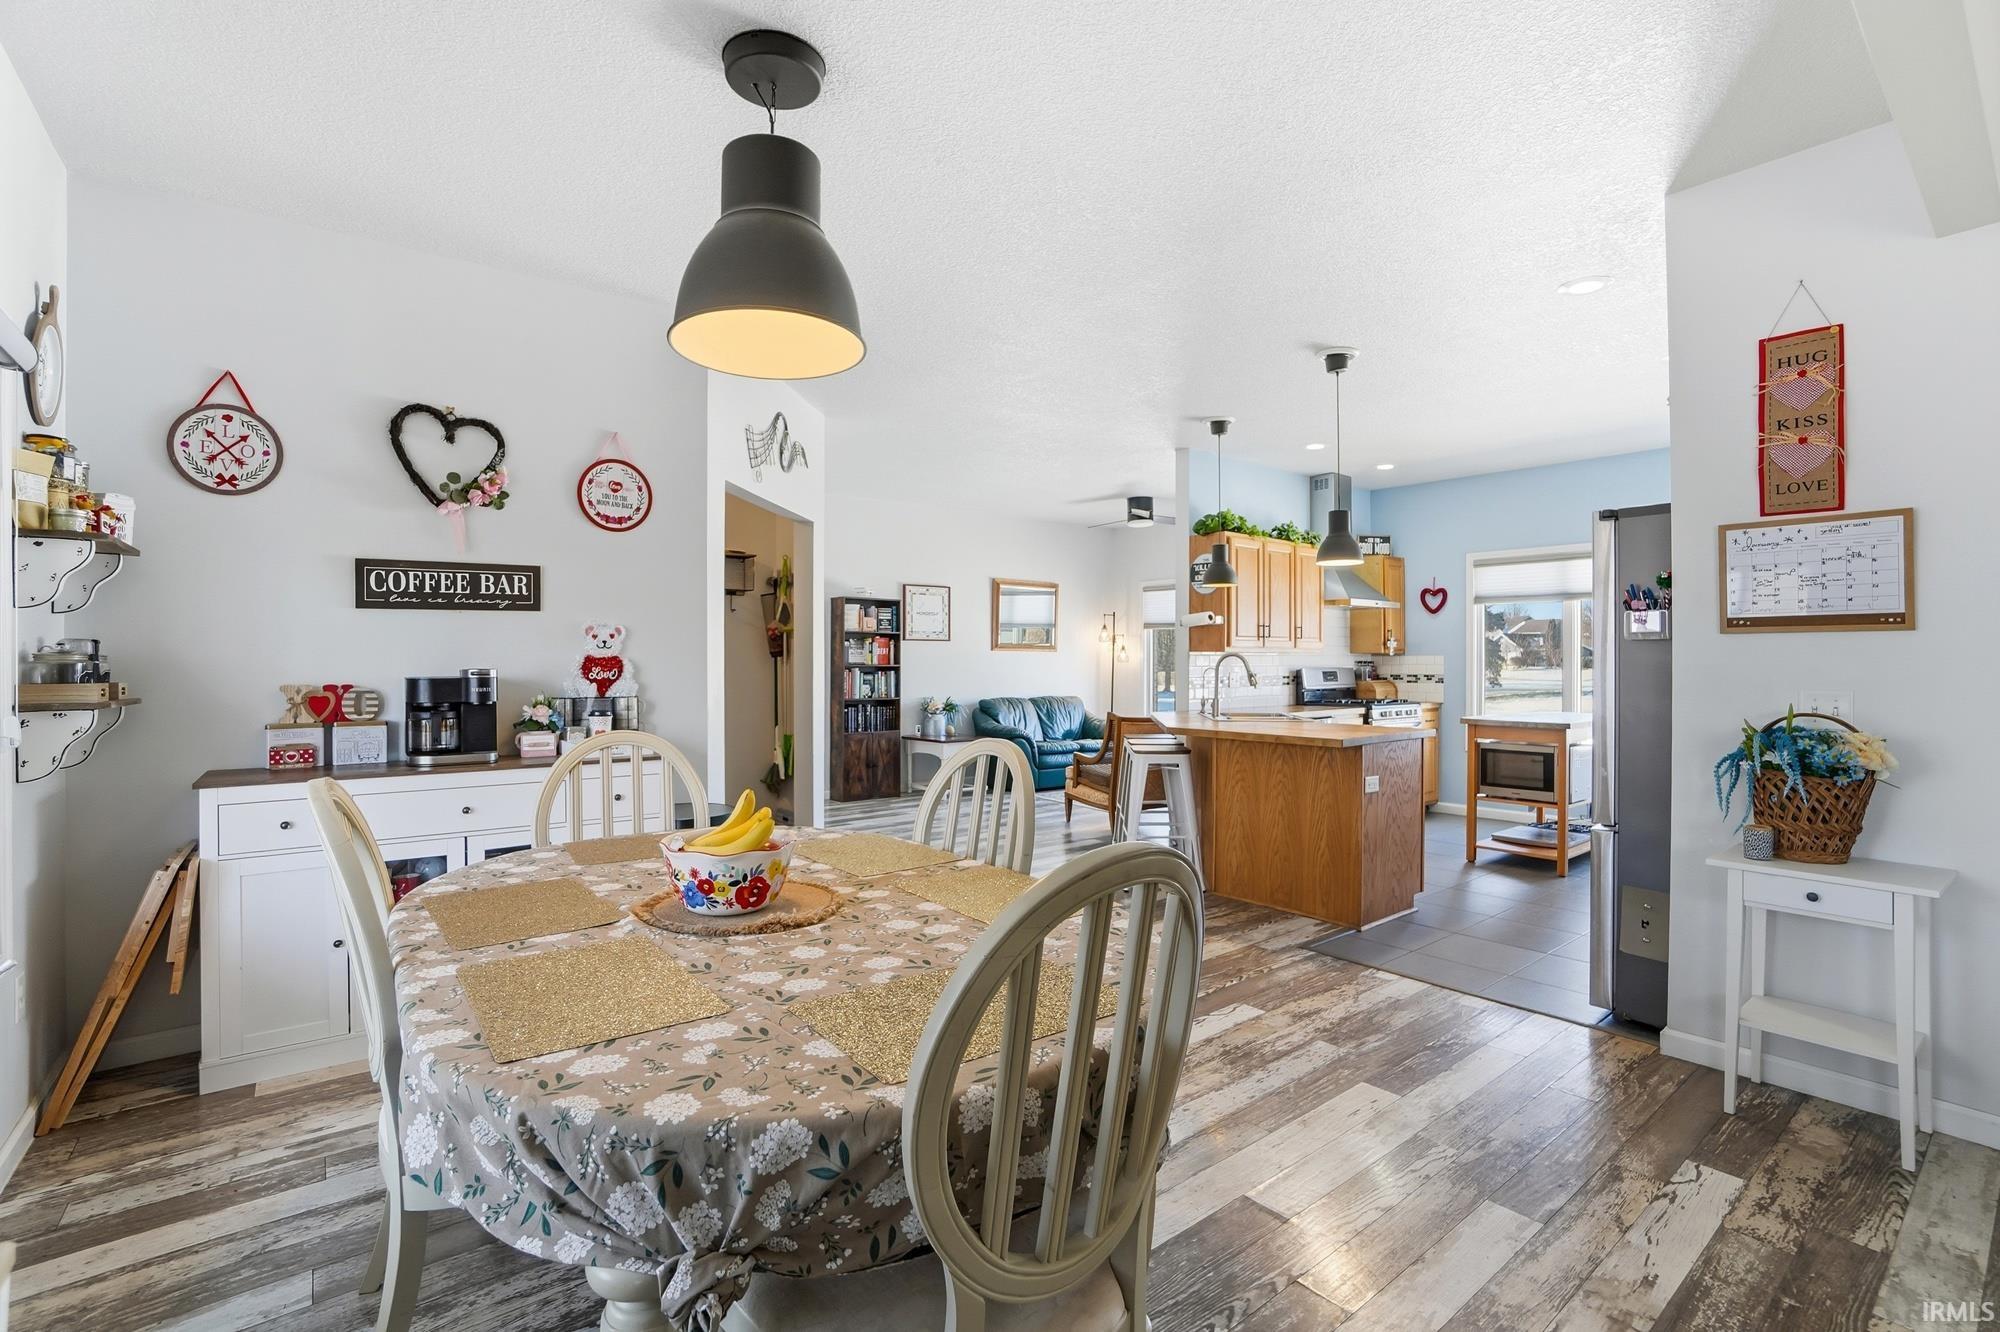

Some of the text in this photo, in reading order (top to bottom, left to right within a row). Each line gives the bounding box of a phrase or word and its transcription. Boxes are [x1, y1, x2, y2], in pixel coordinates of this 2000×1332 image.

[1777, 349, 1828, 369] HUG
[1776, 413, 1828, 431] KISS
[1776, 479, 1829, 495] LOVE
[1742, 536, 1781, 552] January
[369, 570, 529, 596] COFFEE BAR
[588, 666, 618, 680] Love
